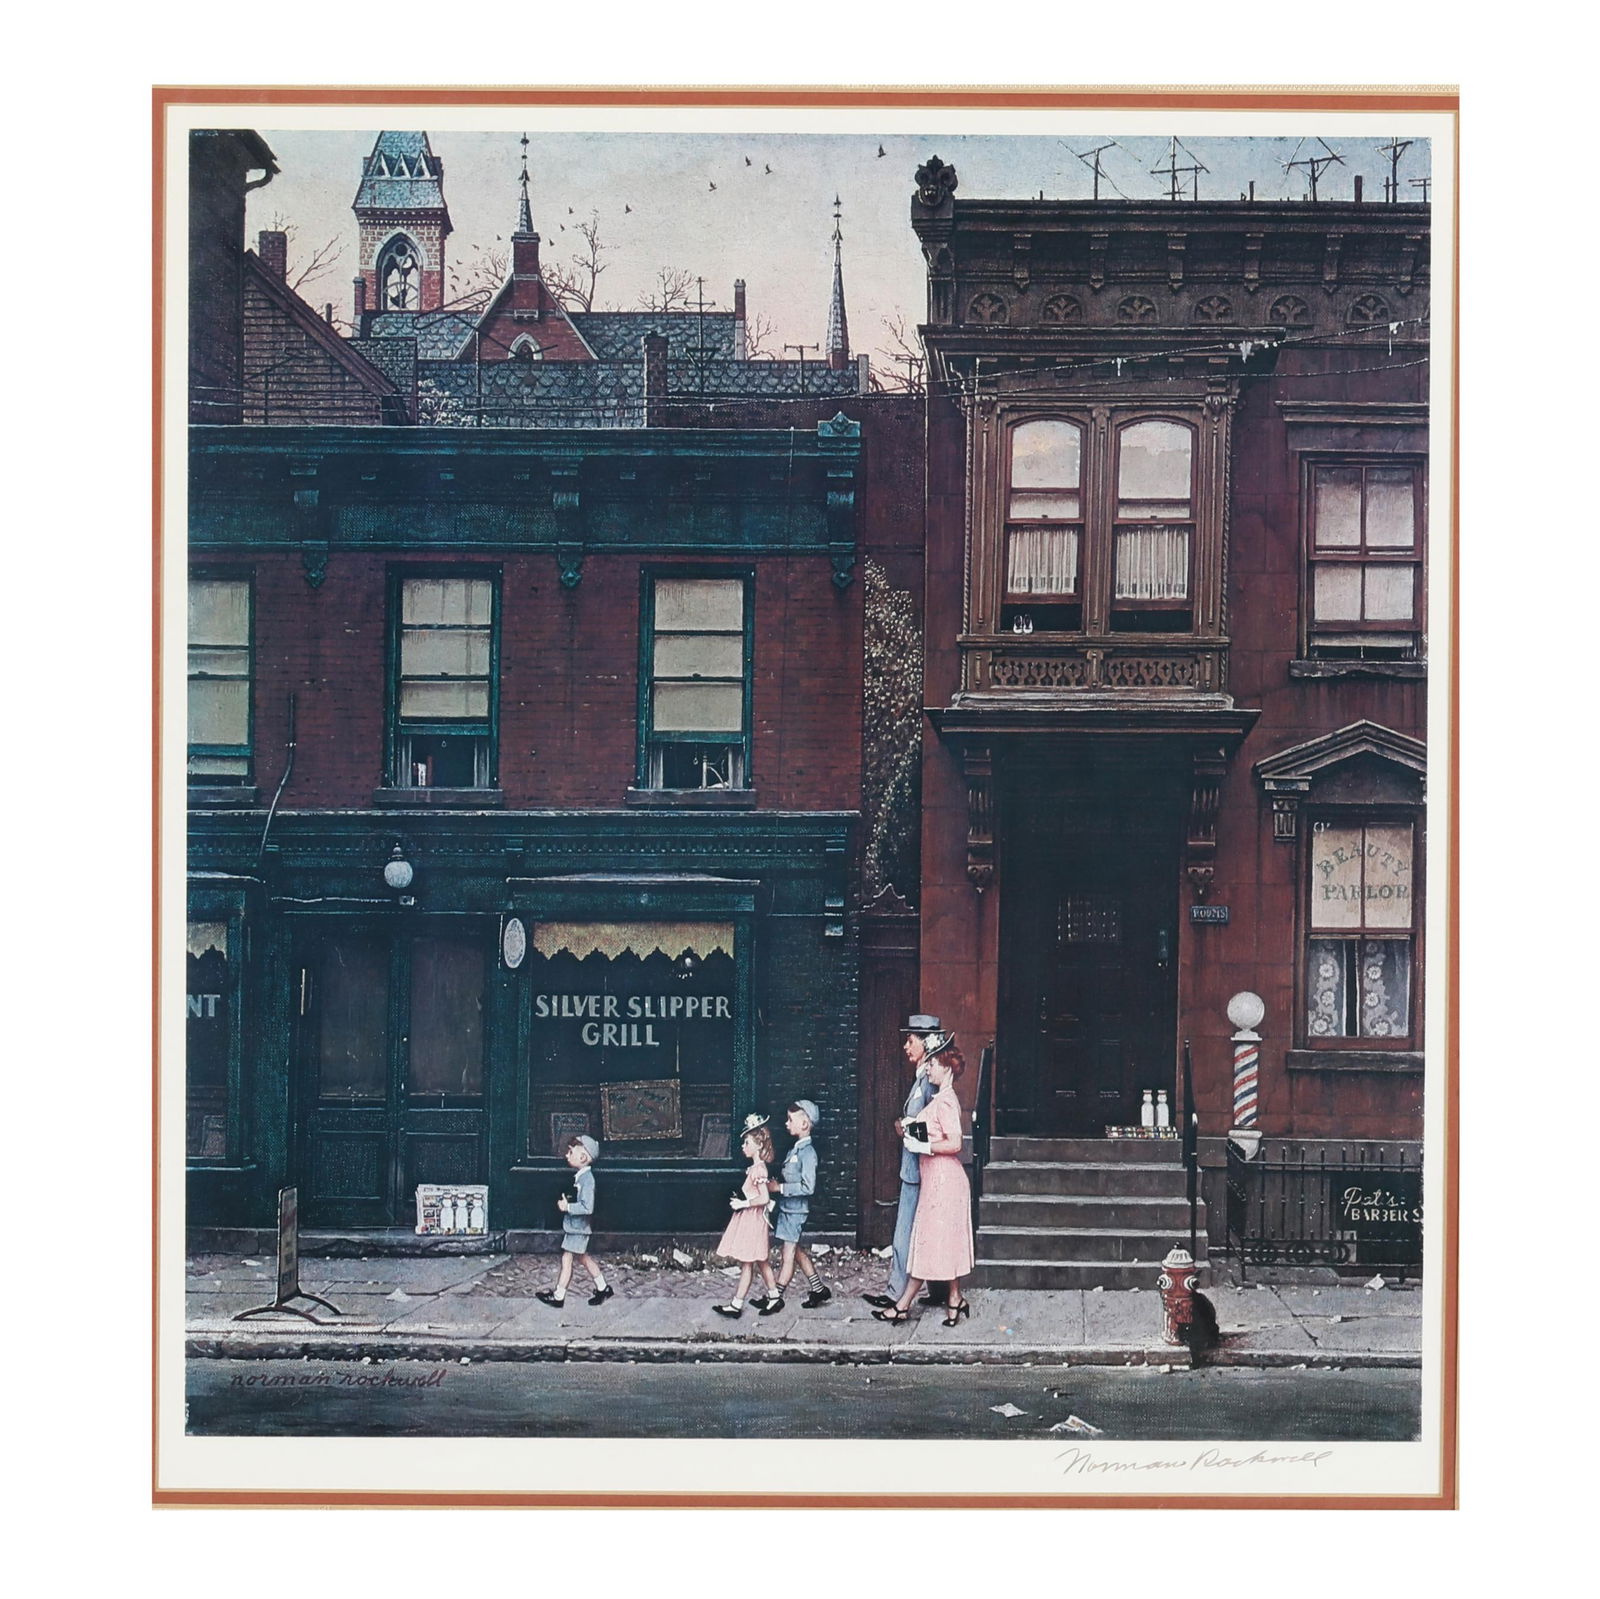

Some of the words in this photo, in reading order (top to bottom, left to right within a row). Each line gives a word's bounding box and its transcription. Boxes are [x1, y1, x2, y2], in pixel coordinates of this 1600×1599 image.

[1316, 840, 1408, 879] BEAUTY
[1322, 884, 1409, 902] PARLOR
[1193, 908, 1226, 919] ROOMS
[535, 995, 620, 1017] SILVER
[627, 996, 731, 1018] SLIPPER
[582, 1022, 660, 1046] GRILL
[1344, 1186, 1398, 1216] Pat's
[231, 1373, 330, 1387] norman
[339, 1368, 447, 1388] rockwell
[1054, 1447, 1186, 1474] Norman
[1190, 1448, 1333, 1471] Rockwell
